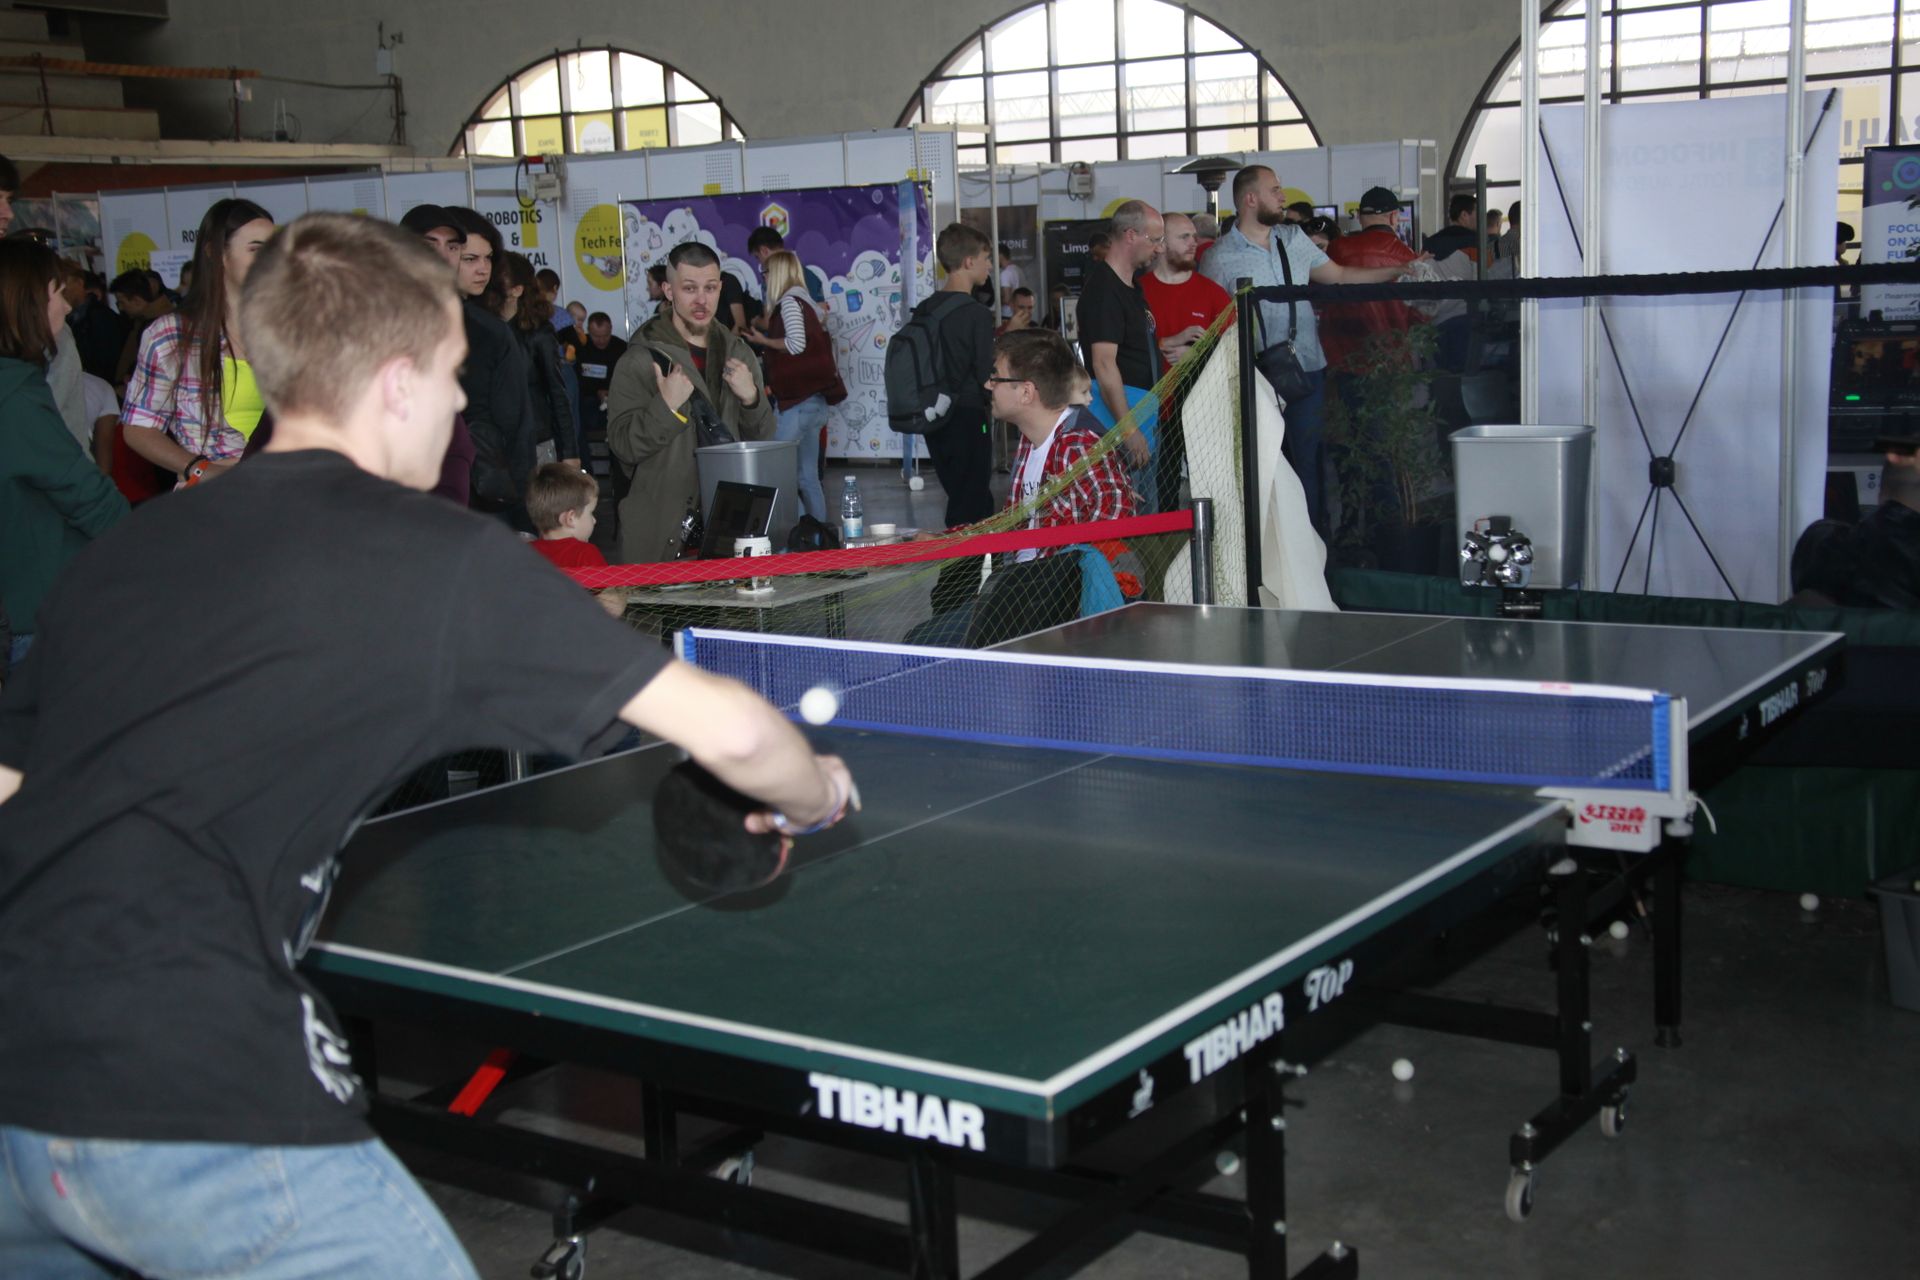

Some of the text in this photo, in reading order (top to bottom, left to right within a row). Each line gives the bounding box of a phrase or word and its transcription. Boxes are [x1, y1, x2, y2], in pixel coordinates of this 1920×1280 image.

[486, 208, 542, 226] ROBOTICS
[581, 236, 607, 250] Tech
[1887, 237, 1906, 247] ON
[1184, 958, 1354, 1085] TIBHAR TOP
[808, 1071, 986, 1153] TIBHAR
